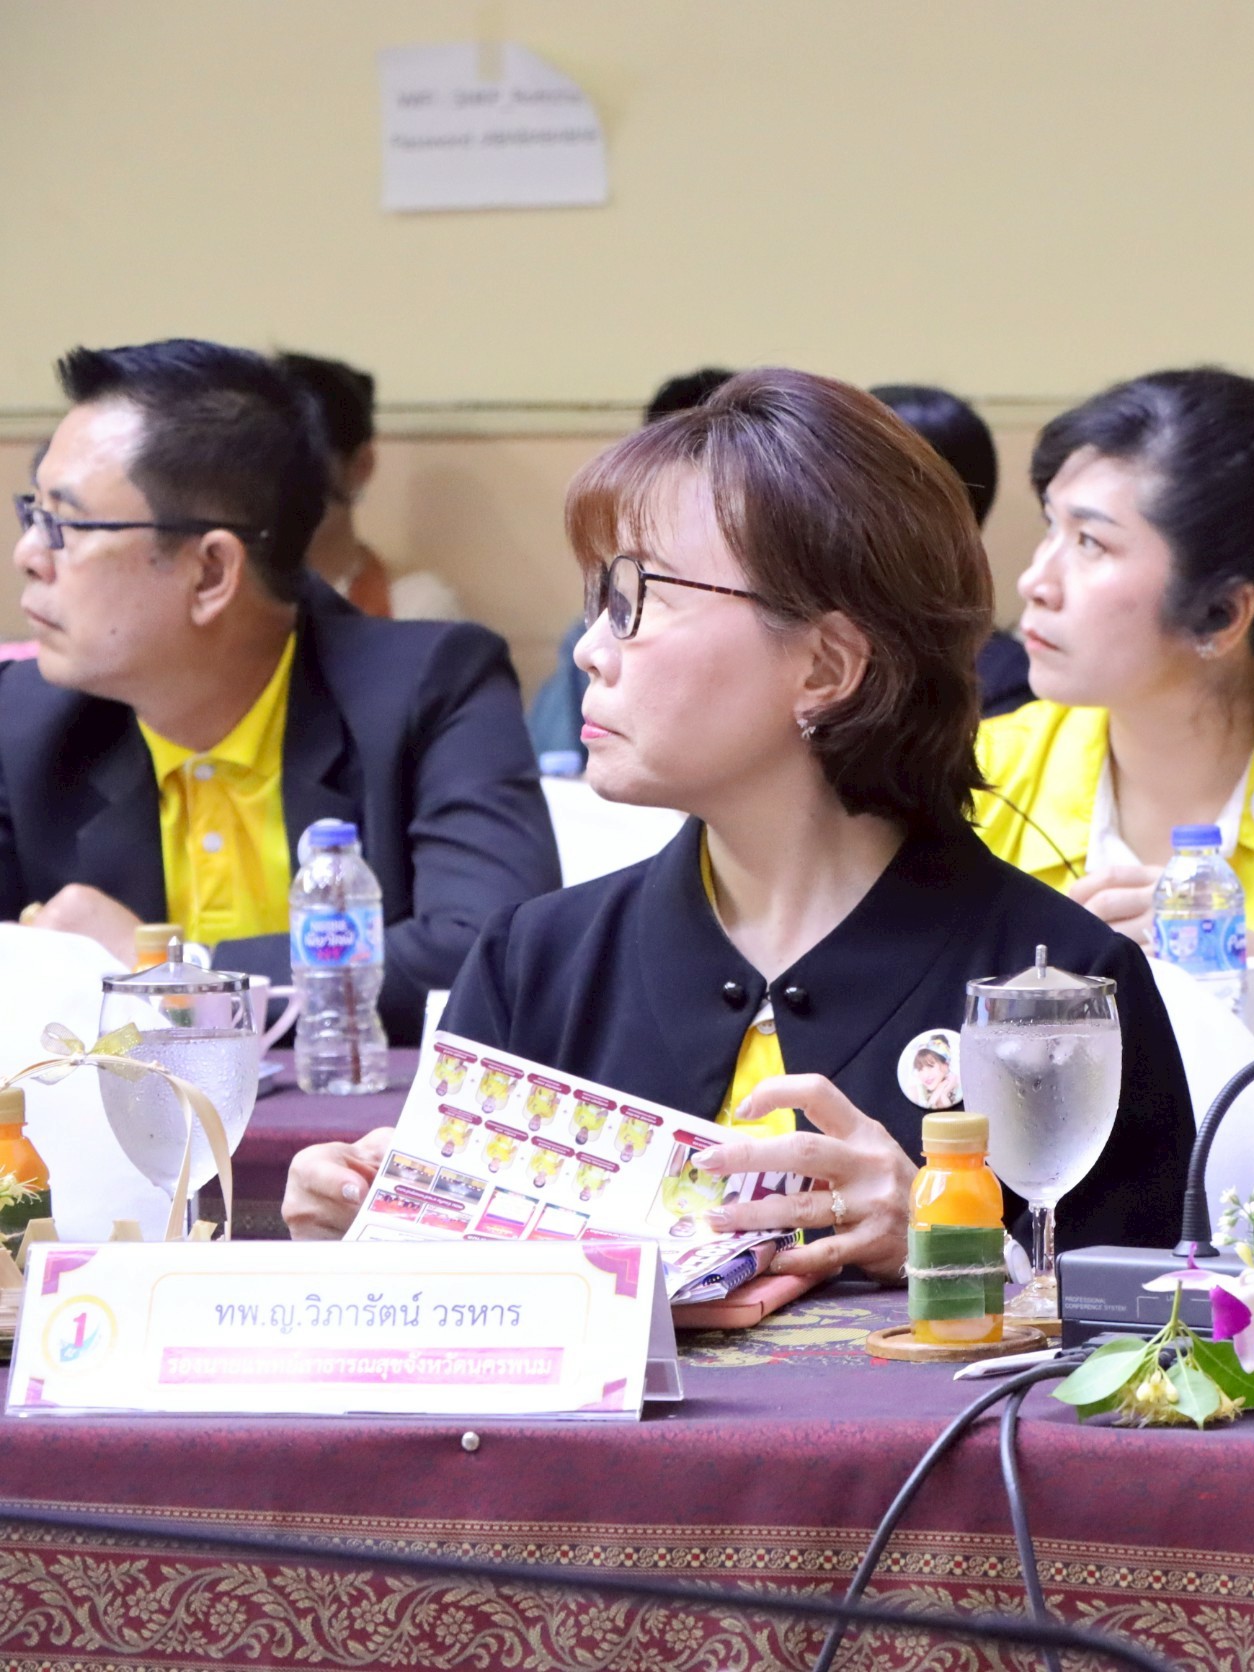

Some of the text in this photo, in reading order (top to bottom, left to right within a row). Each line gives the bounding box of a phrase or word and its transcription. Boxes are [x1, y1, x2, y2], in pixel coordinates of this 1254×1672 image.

[215, 1291, 523, 1335] ทพ.ญ.วิภารัตน์ วรหาร
[1064, 1303, 1127, 1312] CONFERENCE SYSTEM
